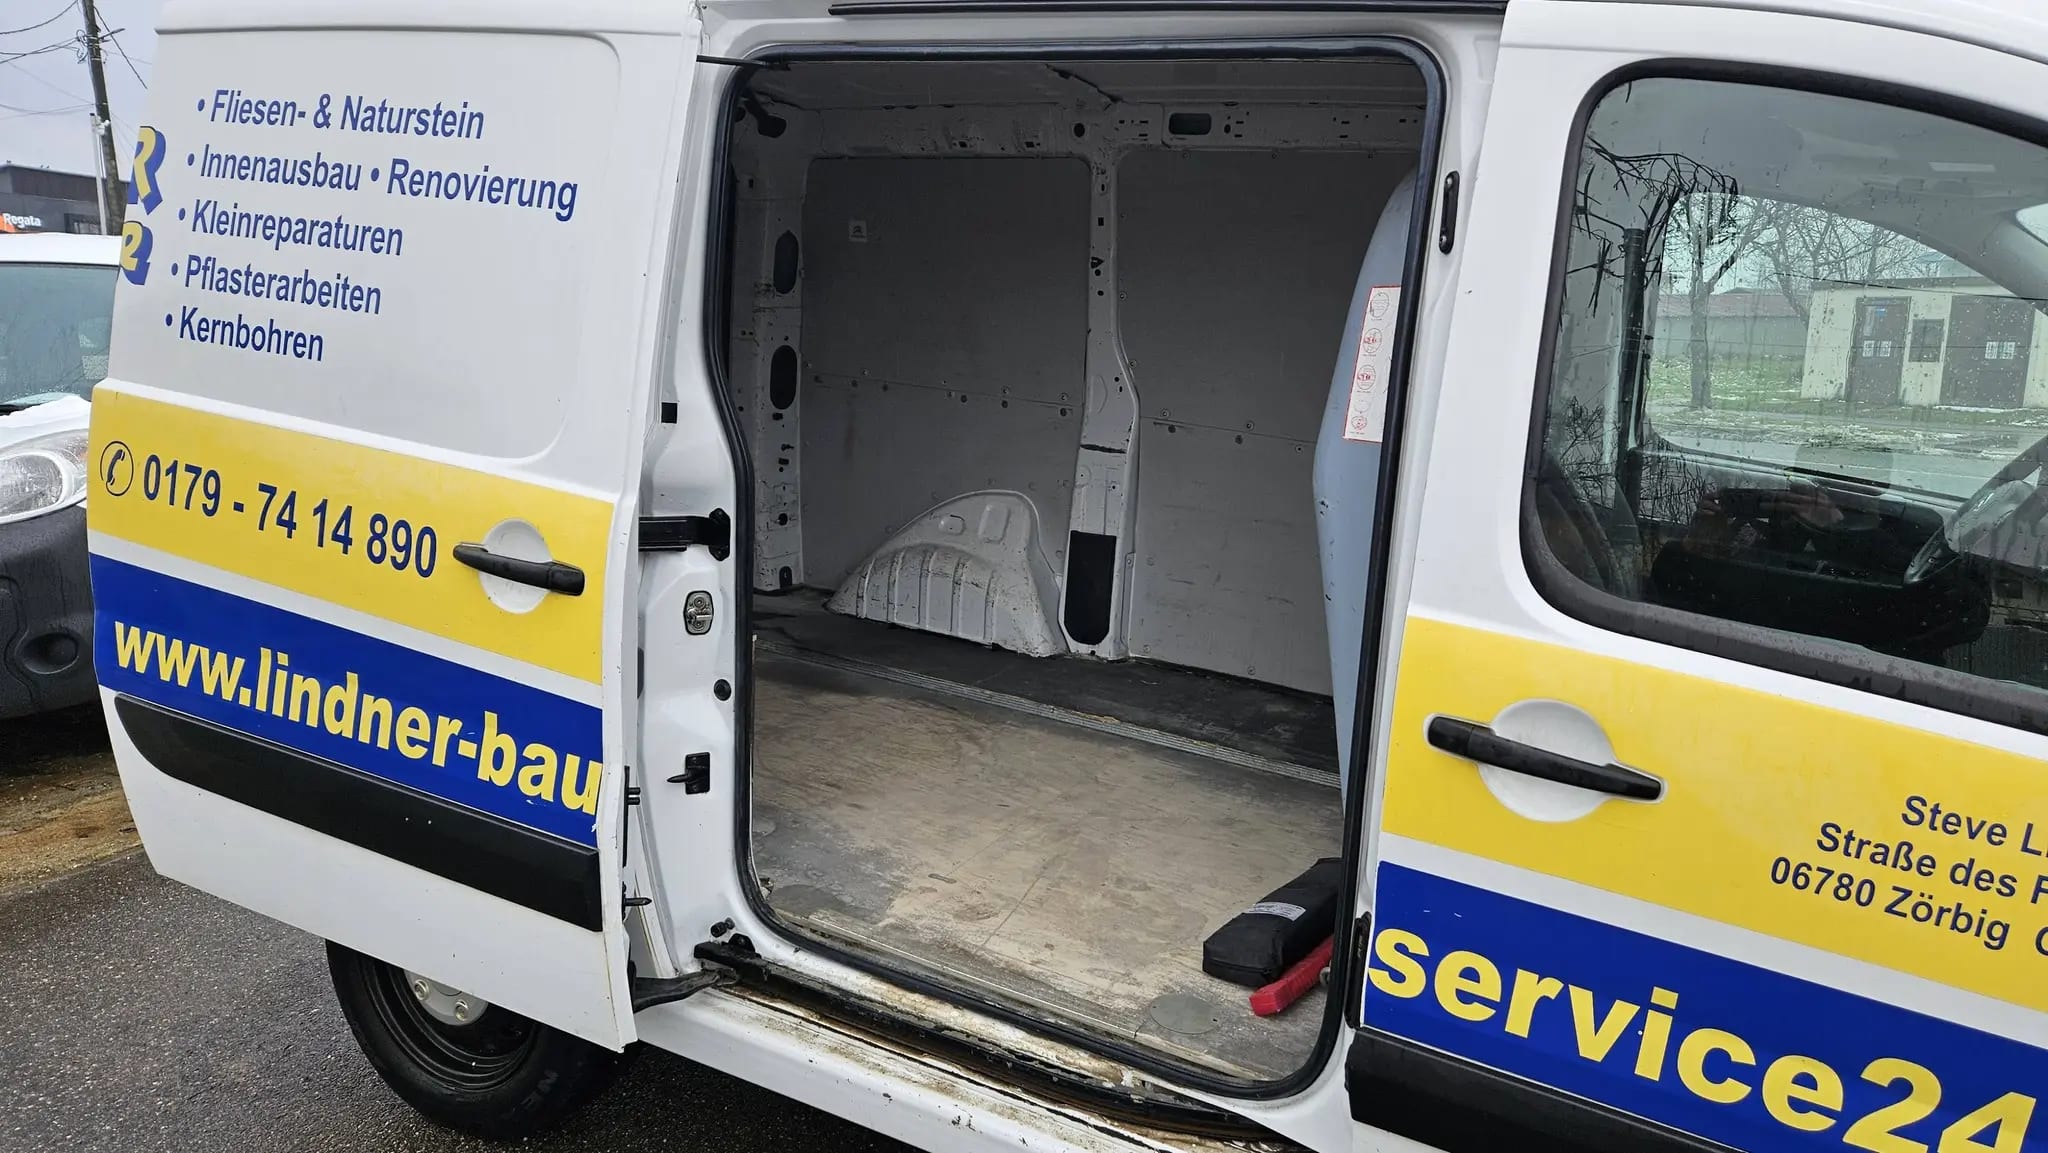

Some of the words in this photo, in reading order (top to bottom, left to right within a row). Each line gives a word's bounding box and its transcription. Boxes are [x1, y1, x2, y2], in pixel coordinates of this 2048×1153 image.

[210, 88, 306, 127] Fliesen-
[312, 93, 331, 129] &
[340, 95, 484, 140] Naturstein
[200, 143, 362, 191] Innenausbau
[387, 157, 579, 222] Renovierung
[2, 212, 42, 229] Regata
[192, 199, 403, 257] Kleinreparaturen
[184, 254, 382, 315] Pflasterarbeiten
[179, 305, 324, 362] Kernbohren
[143, 454, 221, 518] 0179
[232, 501, 245, 513] -
[257, 482, 297, 540] 74
[312, 498, 353, 556] 14
[366, 513, 437, 579] 890
[115, 620, 604, 816] www.lindner-bau
[1901, 795, 2008, 847] Steve
[1816, 822, 1937, 877] Straße
[1949, 857, 2018, 898] des
[1770, 856, 1876, 907] 06780
[1883, 885, 2011, 951] Zörbig
[1368, 928, 2038, 1153] service24
